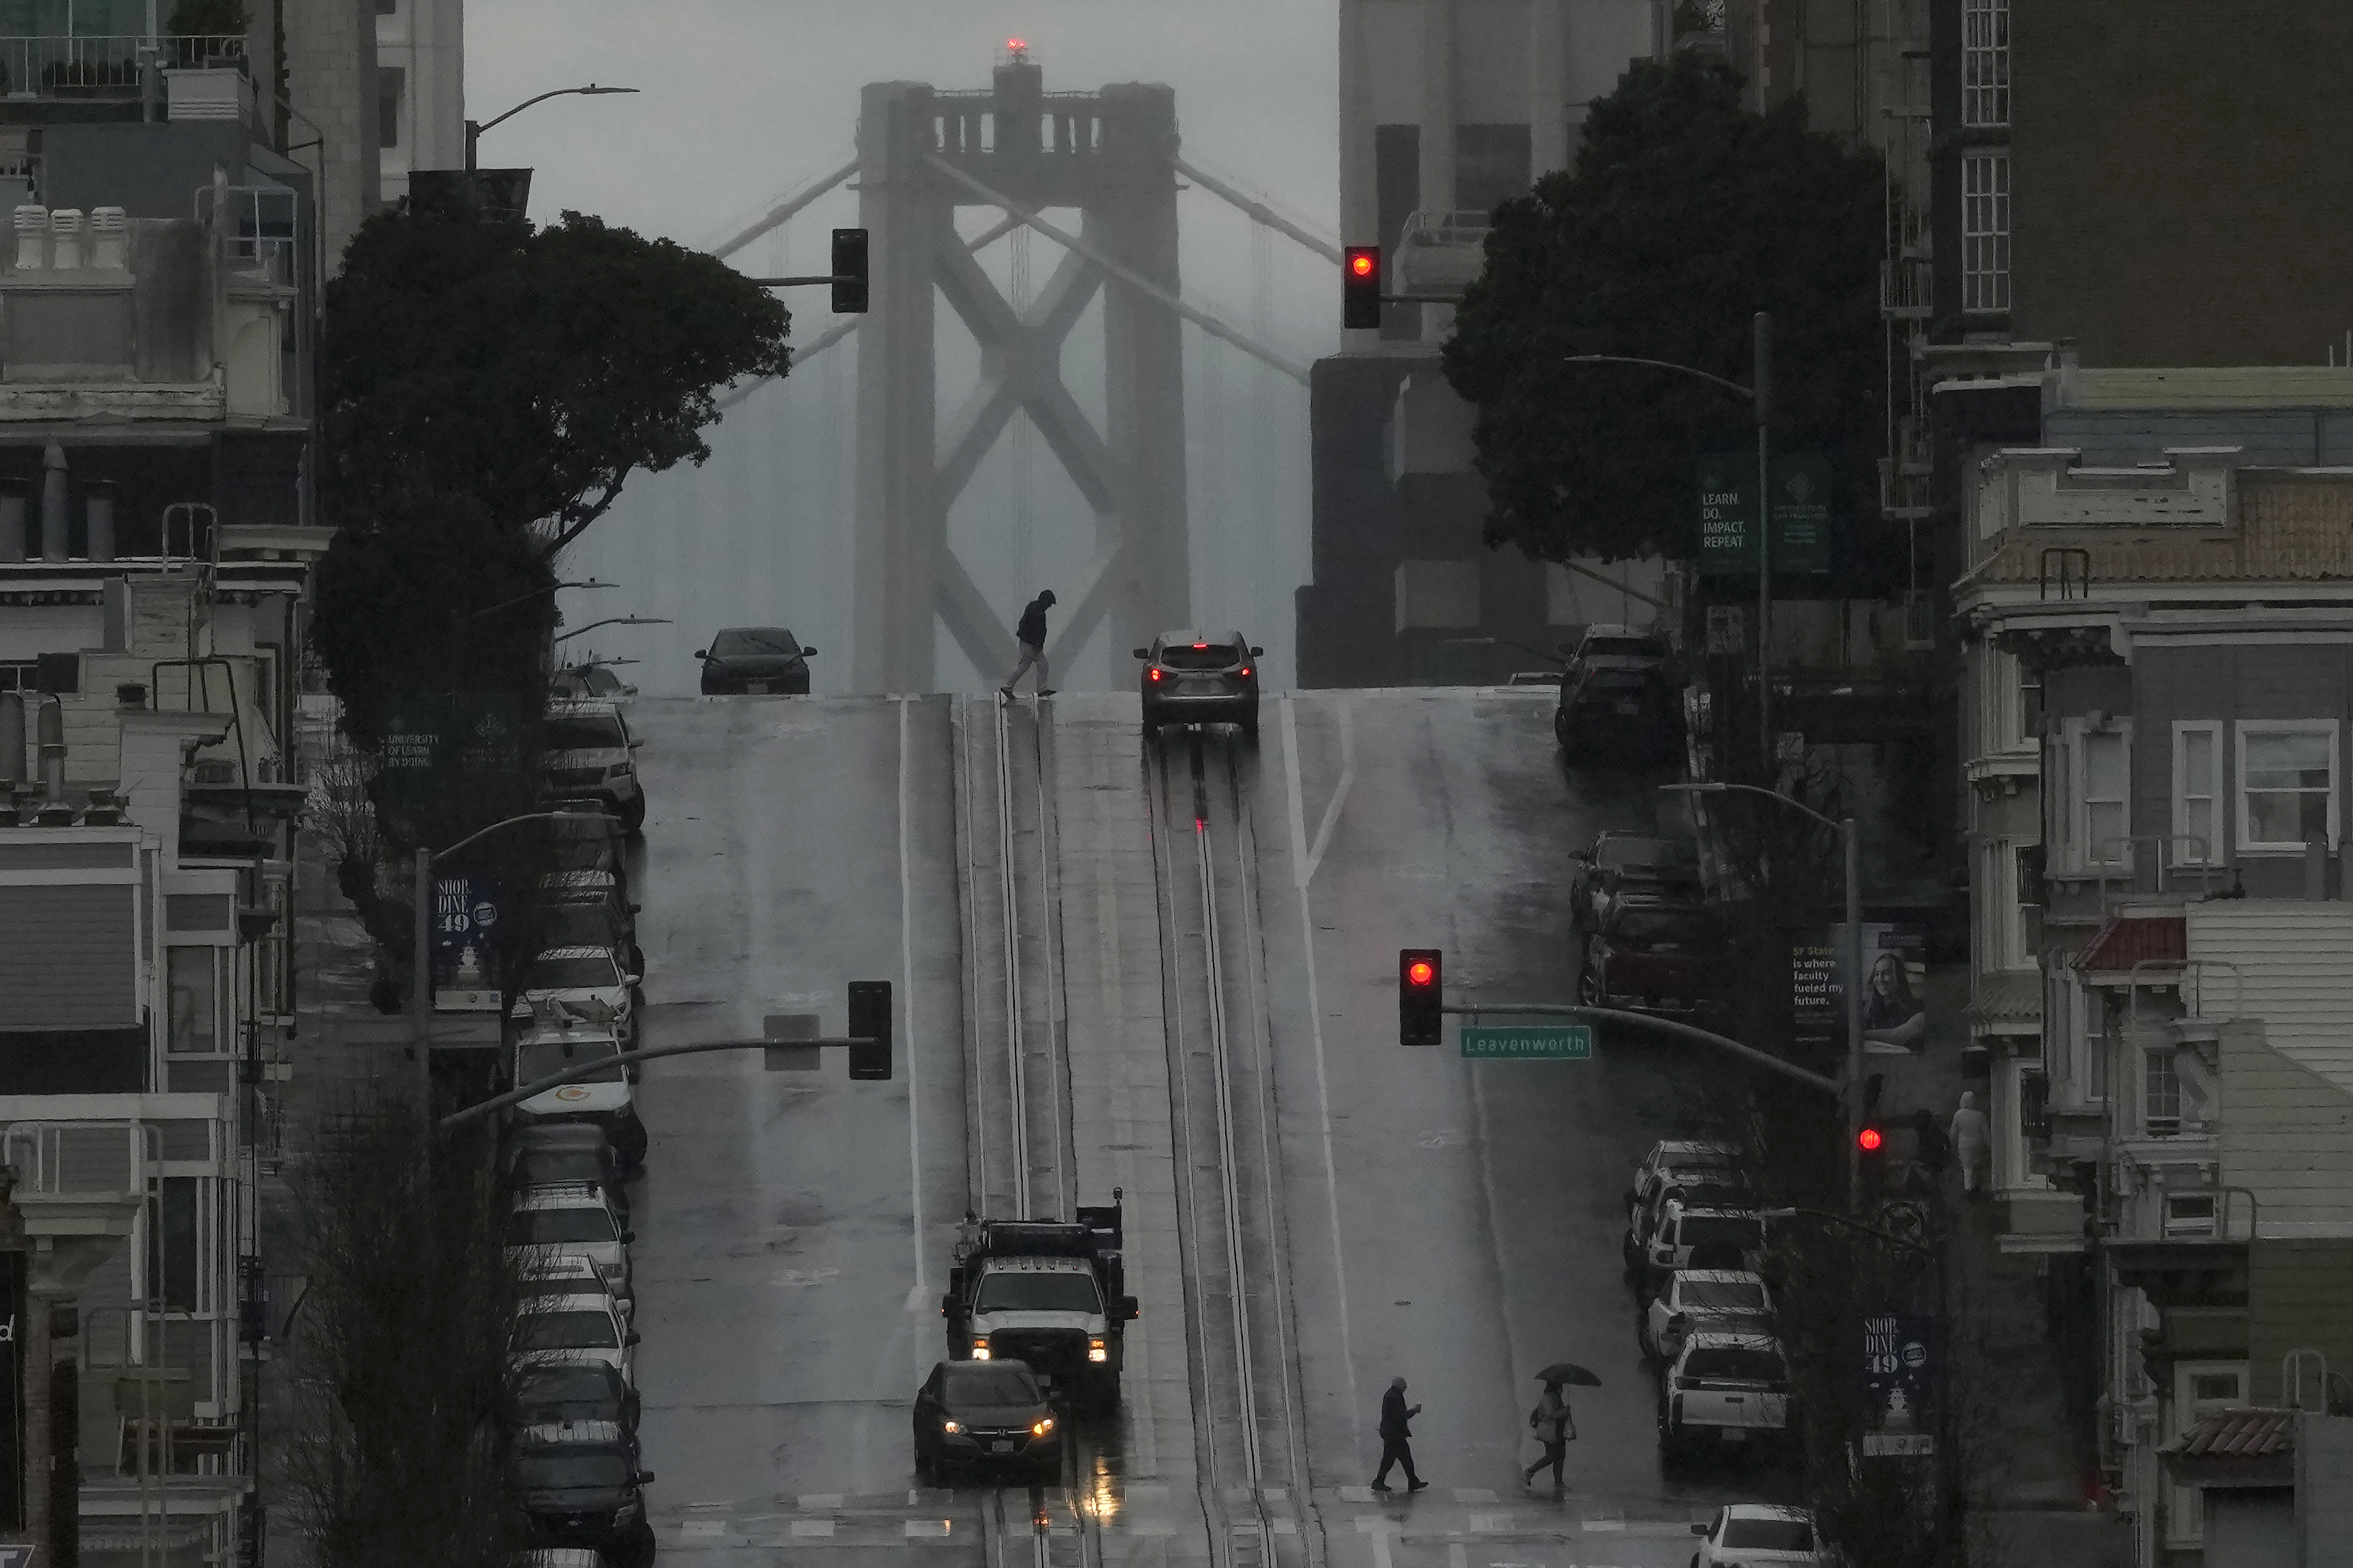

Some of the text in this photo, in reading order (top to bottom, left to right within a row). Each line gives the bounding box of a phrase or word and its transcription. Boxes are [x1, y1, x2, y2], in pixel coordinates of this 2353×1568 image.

[1703, 493, 1739, 505] LEARN.
[1703, 508, 1722, 519] DO.
[1704, 521, 1746, 534] IMPACT.
[1703, 535, 1745, 548] REPEAT.
[438, 895, 468, 913] DINE
[438, 914, 469, 932] 49
[1793, 946, 1835, 956] SF State
[1793, 958, 1835, 968] is where
[1794, 972, 1830, 982] faculty
[1794, 982, 1844, 993] fueled my
[1794, 997, 1830, 1006] future.
[1466, 1035, 1584, 1052] Leavenworth
[1866, 1334, 1897, 1354] DINE
[1865, 1354, 1898, 1373] 49
